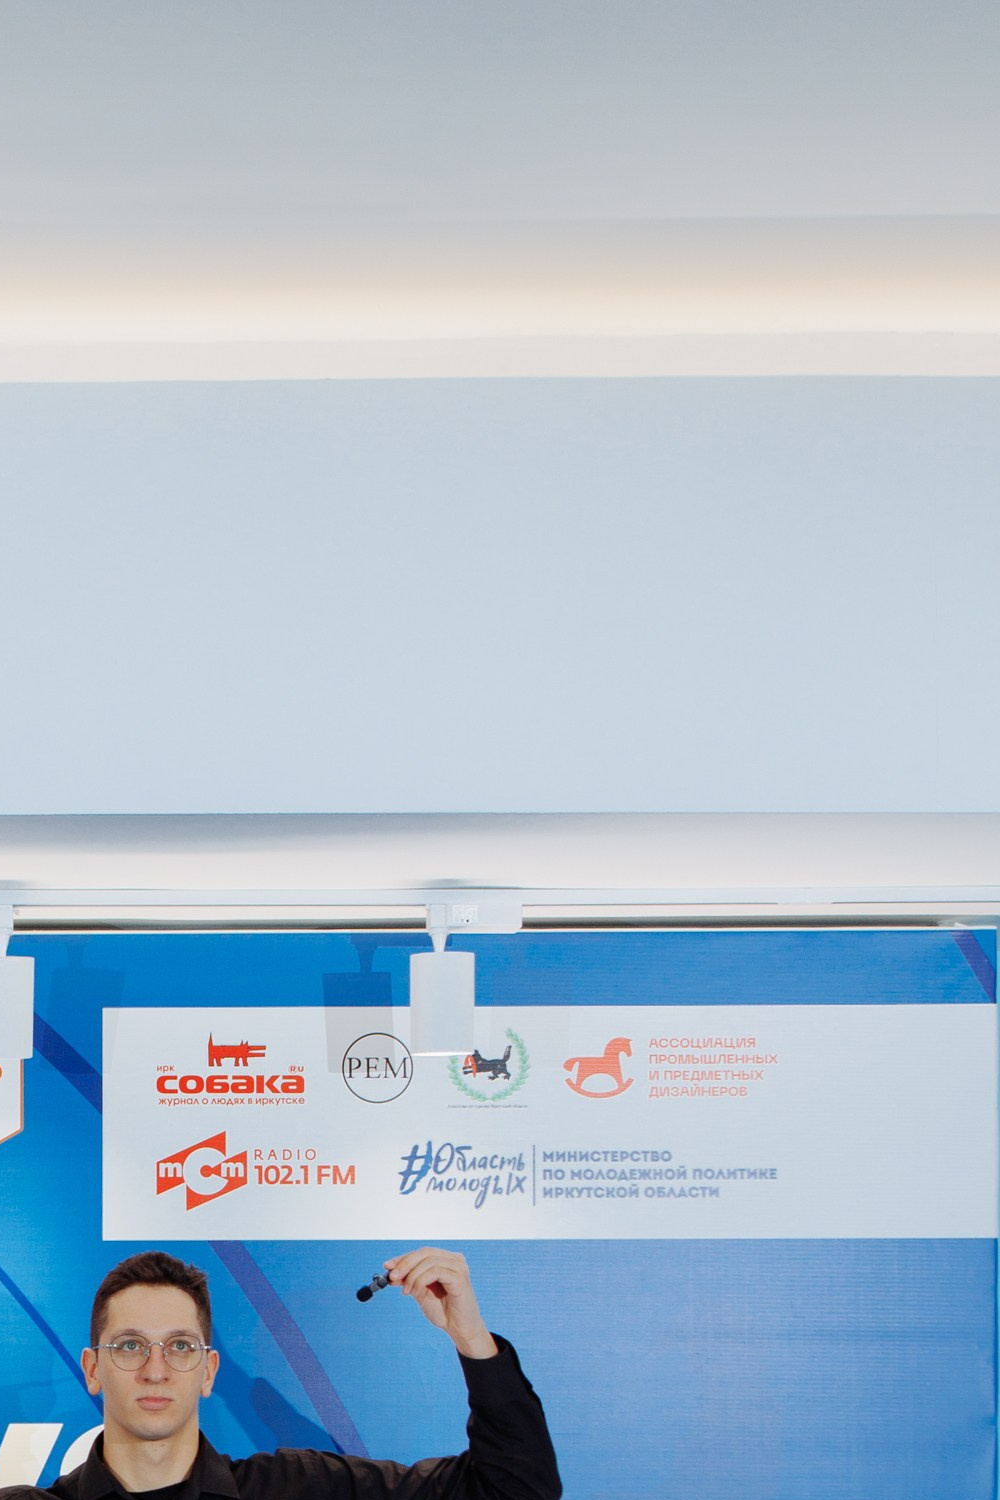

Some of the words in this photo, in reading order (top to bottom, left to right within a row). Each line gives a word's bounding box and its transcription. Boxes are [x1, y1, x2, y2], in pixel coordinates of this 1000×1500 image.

[649, 1037, 756, 1050] АССОЦИАЦИЯ
[649, 1053, 778, 1065] ПРОМЫШЛЕННЫХ
[649, 1070, 660, 1081] И
[664, 1070, 765, 1082] ПРЕДМЕТНЫХ
[649, 1083, 748, 1098] ДИЗАЙНЕРОВ
[158, 1097, 199, 1106] журнал
[202, 1097, 209, 1105] о
[211, 1097, 245, 1106] людях
[248, 1097, 253, 1105] в
[256, 1097, 306, 1106] иркутске
[254, 1149, 317, 1161] RADIO
[542, 1150, 673, 1162] МИНИСТЕРСТВО
[254, 1165, 309, 1185] 102.1
[317, 1165, 356, 1185] FM
[542, 1168, 565, 1180] ПО
[570, 1166, 688, 1181] МОЛОДЕЖНОЙ
[692, 1168, 778, 1180] ПОЛИТИКЕ
[542, 1184, 640, 1198] ИРКУТСКОЙ
[644, 1186, 720, 1198] ОБЛАСТИ
